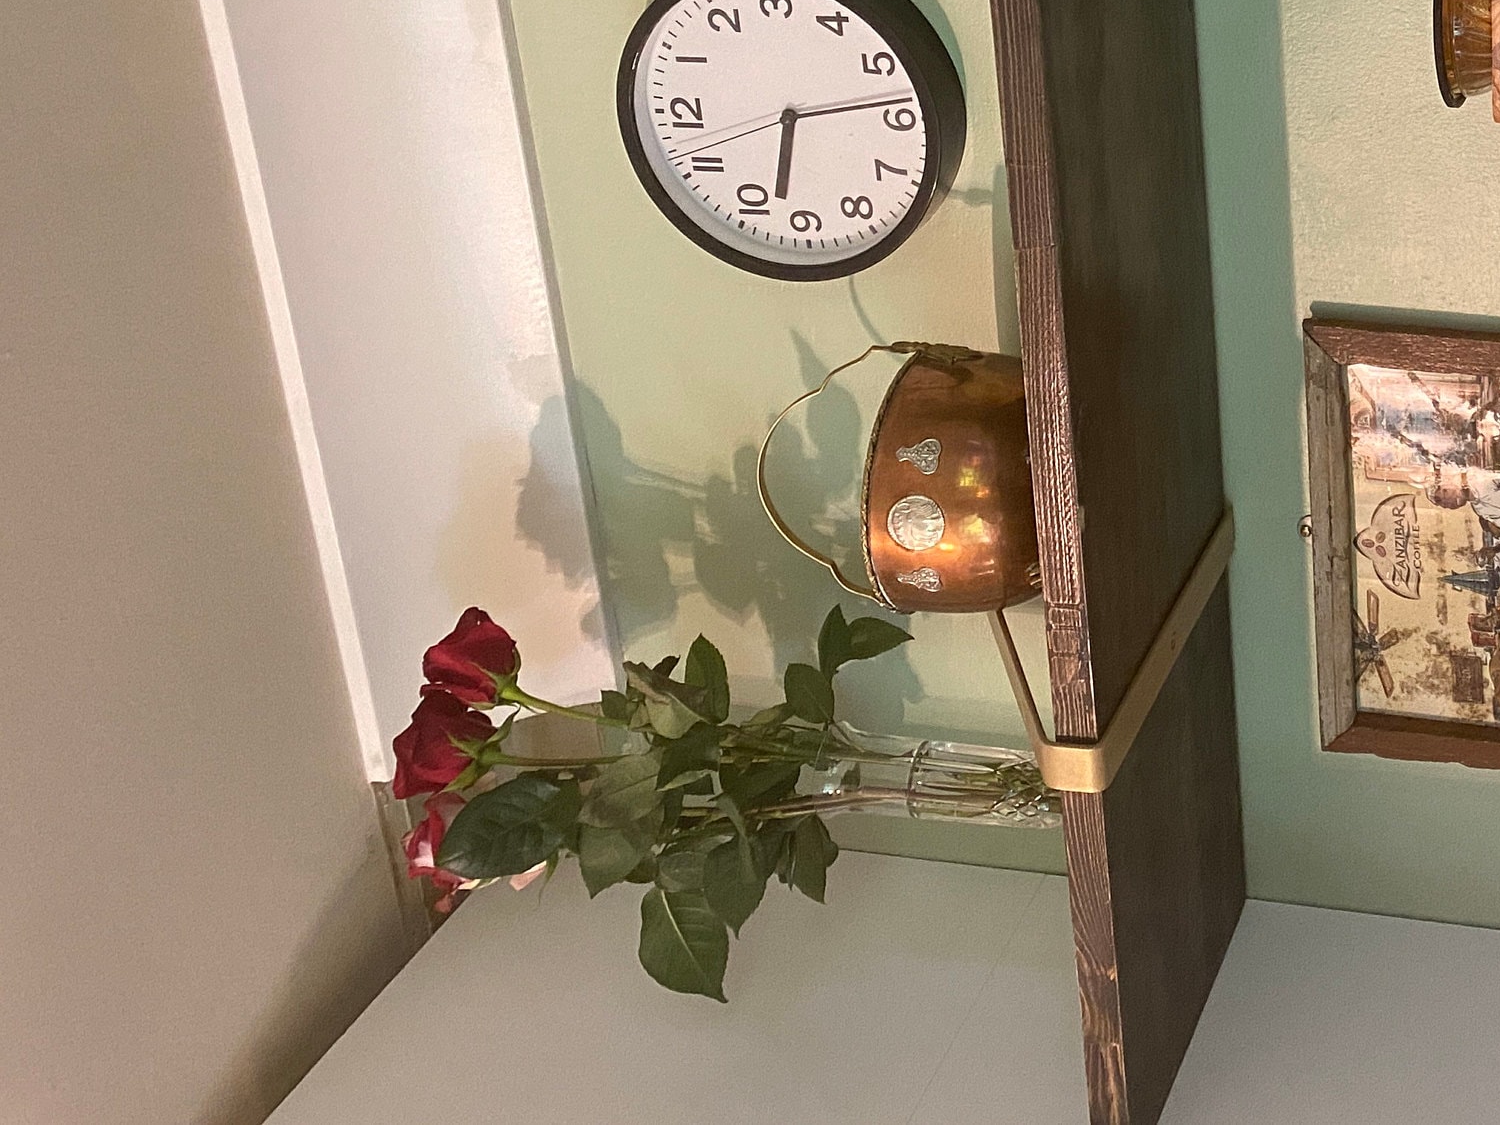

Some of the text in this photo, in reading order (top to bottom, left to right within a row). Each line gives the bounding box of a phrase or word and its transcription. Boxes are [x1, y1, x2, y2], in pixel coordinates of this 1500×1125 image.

[707, 8, 741, 33] 2
[816, 11, 849, 37] 4
[675, 56, 707, 64] 1
[861, 52, 895, 77] 5
[669, 97, 704, 129] 12
[883, 108, 916, 132] 6
[691, 156, 724, 173] 11
[875, 158, 908, 181] 7
[736, 183, 770, 215] 10
[840, 195, 873, 220] 8
[789, 209, 822, 233] 9
[1392, 501, 1410, 590] ZANZIBAR
